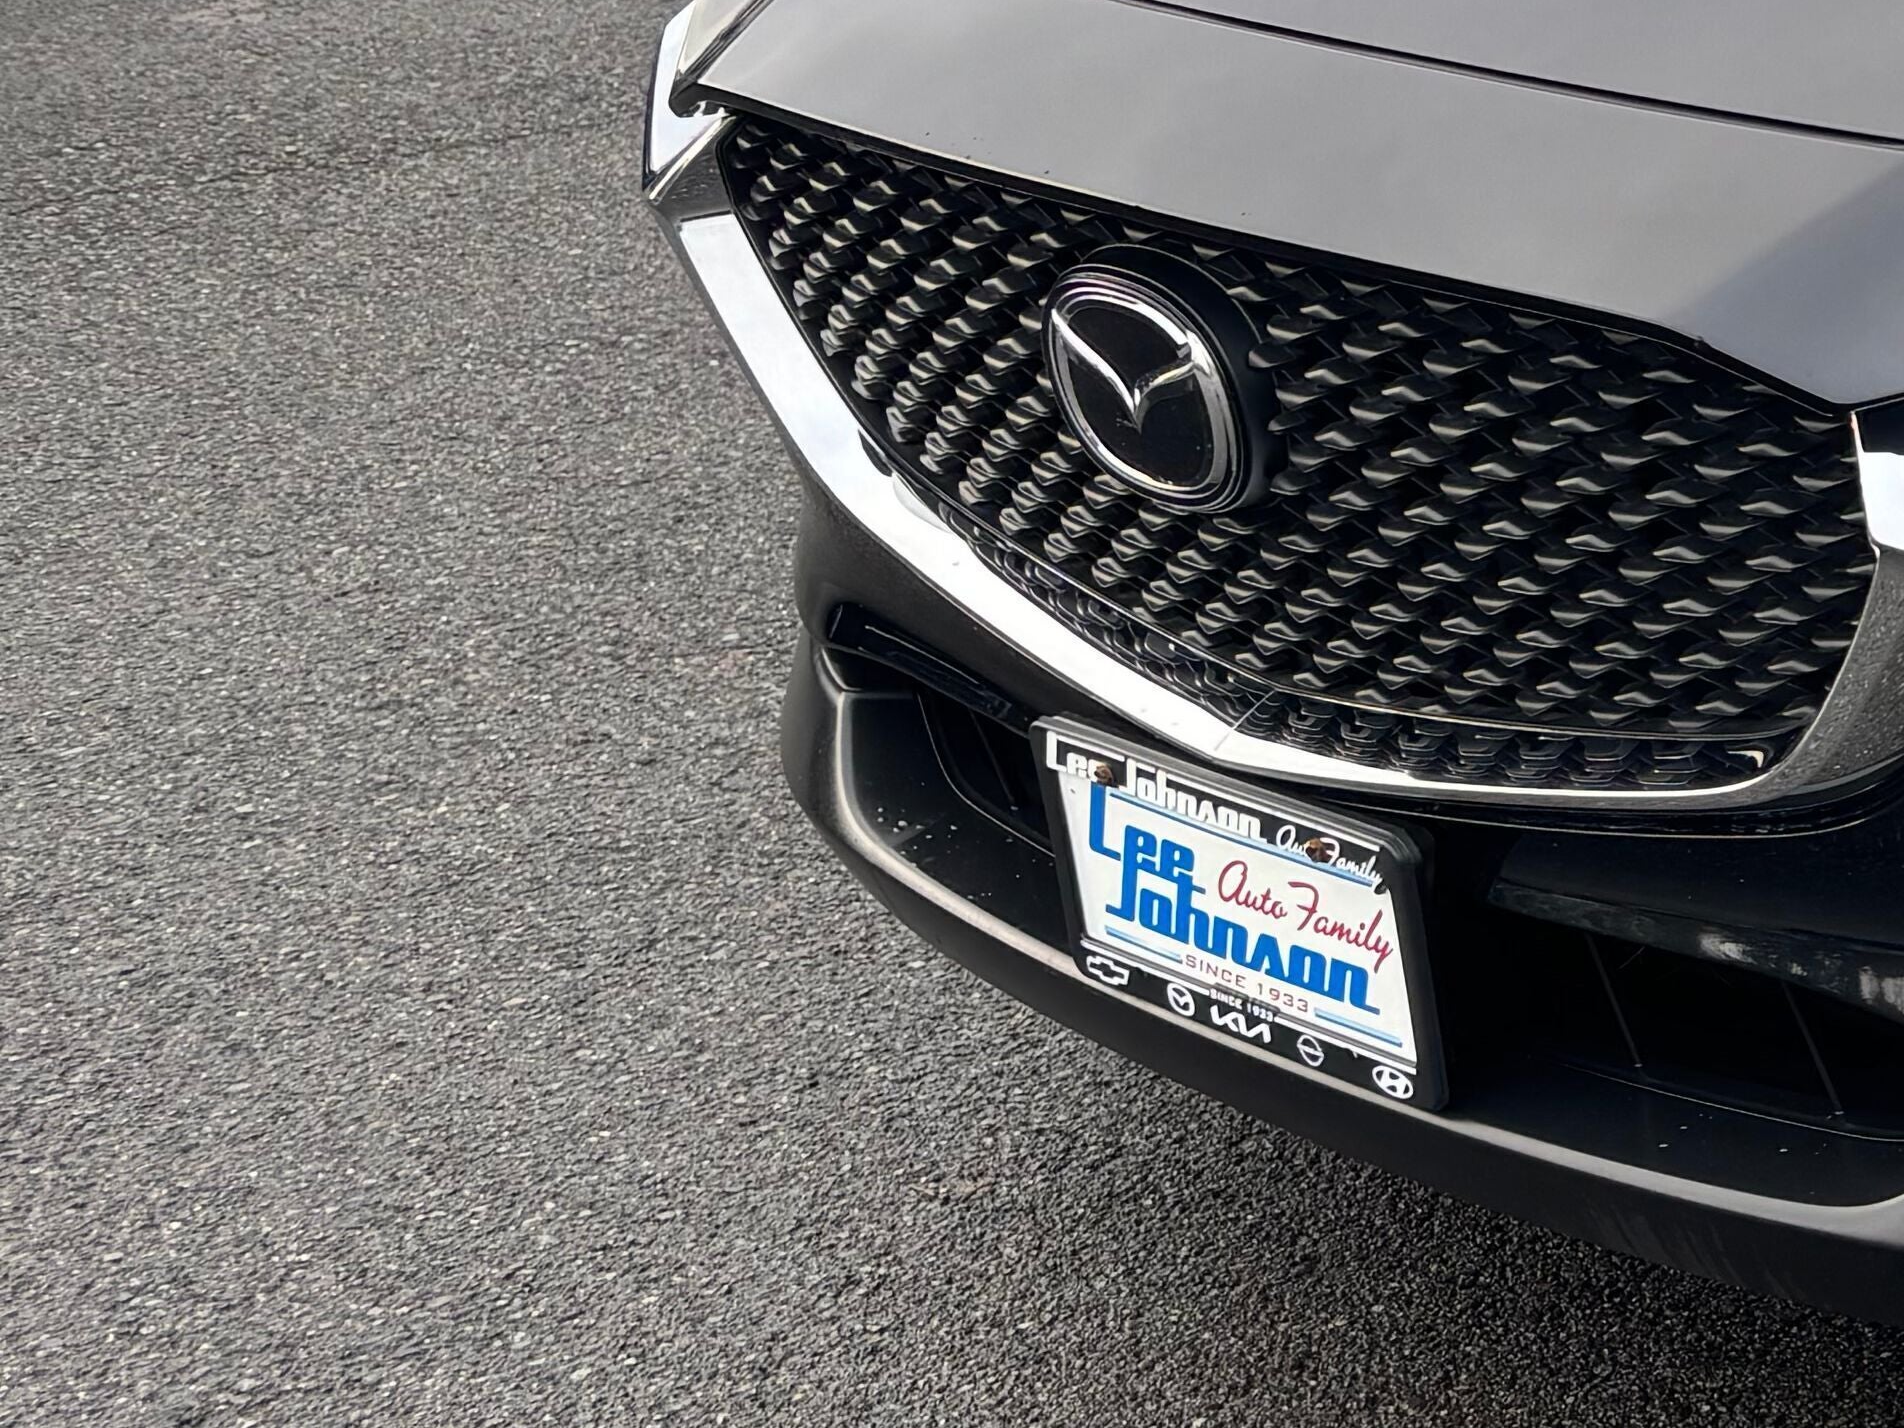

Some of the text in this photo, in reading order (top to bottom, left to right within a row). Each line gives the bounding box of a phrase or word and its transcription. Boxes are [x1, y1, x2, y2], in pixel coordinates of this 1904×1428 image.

[1089, 779, 1206, 895] Lee
[1119, 758, 1268, 846] Johnson
[1105, 864, 1380, 1016] Johnson
[1218, 860, 1393, 974] Auto Family
[1186, 955, 1309, 1014] SINCE 1933
[1209, 987, 1244, 1011] SINCE
